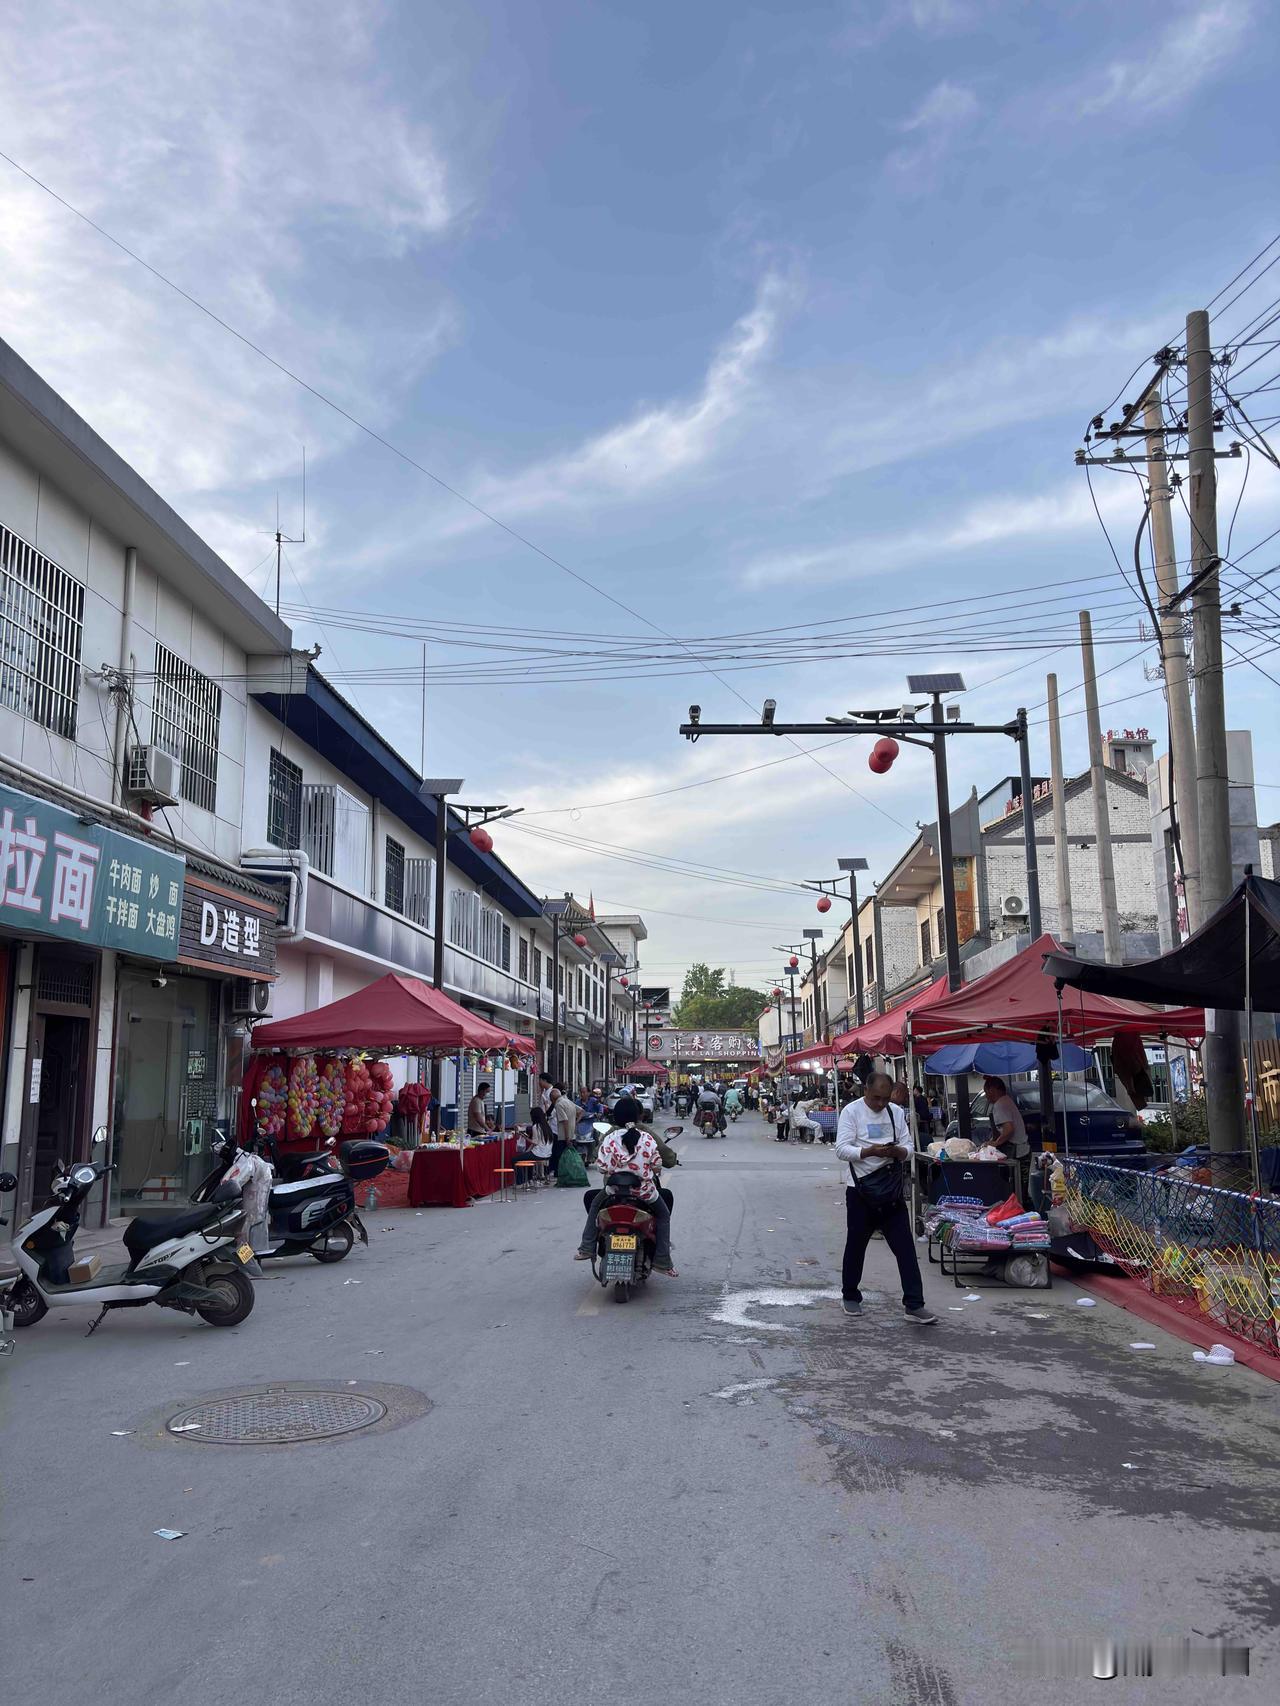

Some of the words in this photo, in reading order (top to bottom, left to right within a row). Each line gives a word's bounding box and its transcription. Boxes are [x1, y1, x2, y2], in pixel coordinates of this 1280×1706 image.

[0, 808, 100, 929] 拉面
[109, 859, 142, 894] 牛肉面
[106, 896, 139, 929] 干拌面
[145, 908, 176, 940] 大盘鸡
[200, 901, 260, 957] D造型
